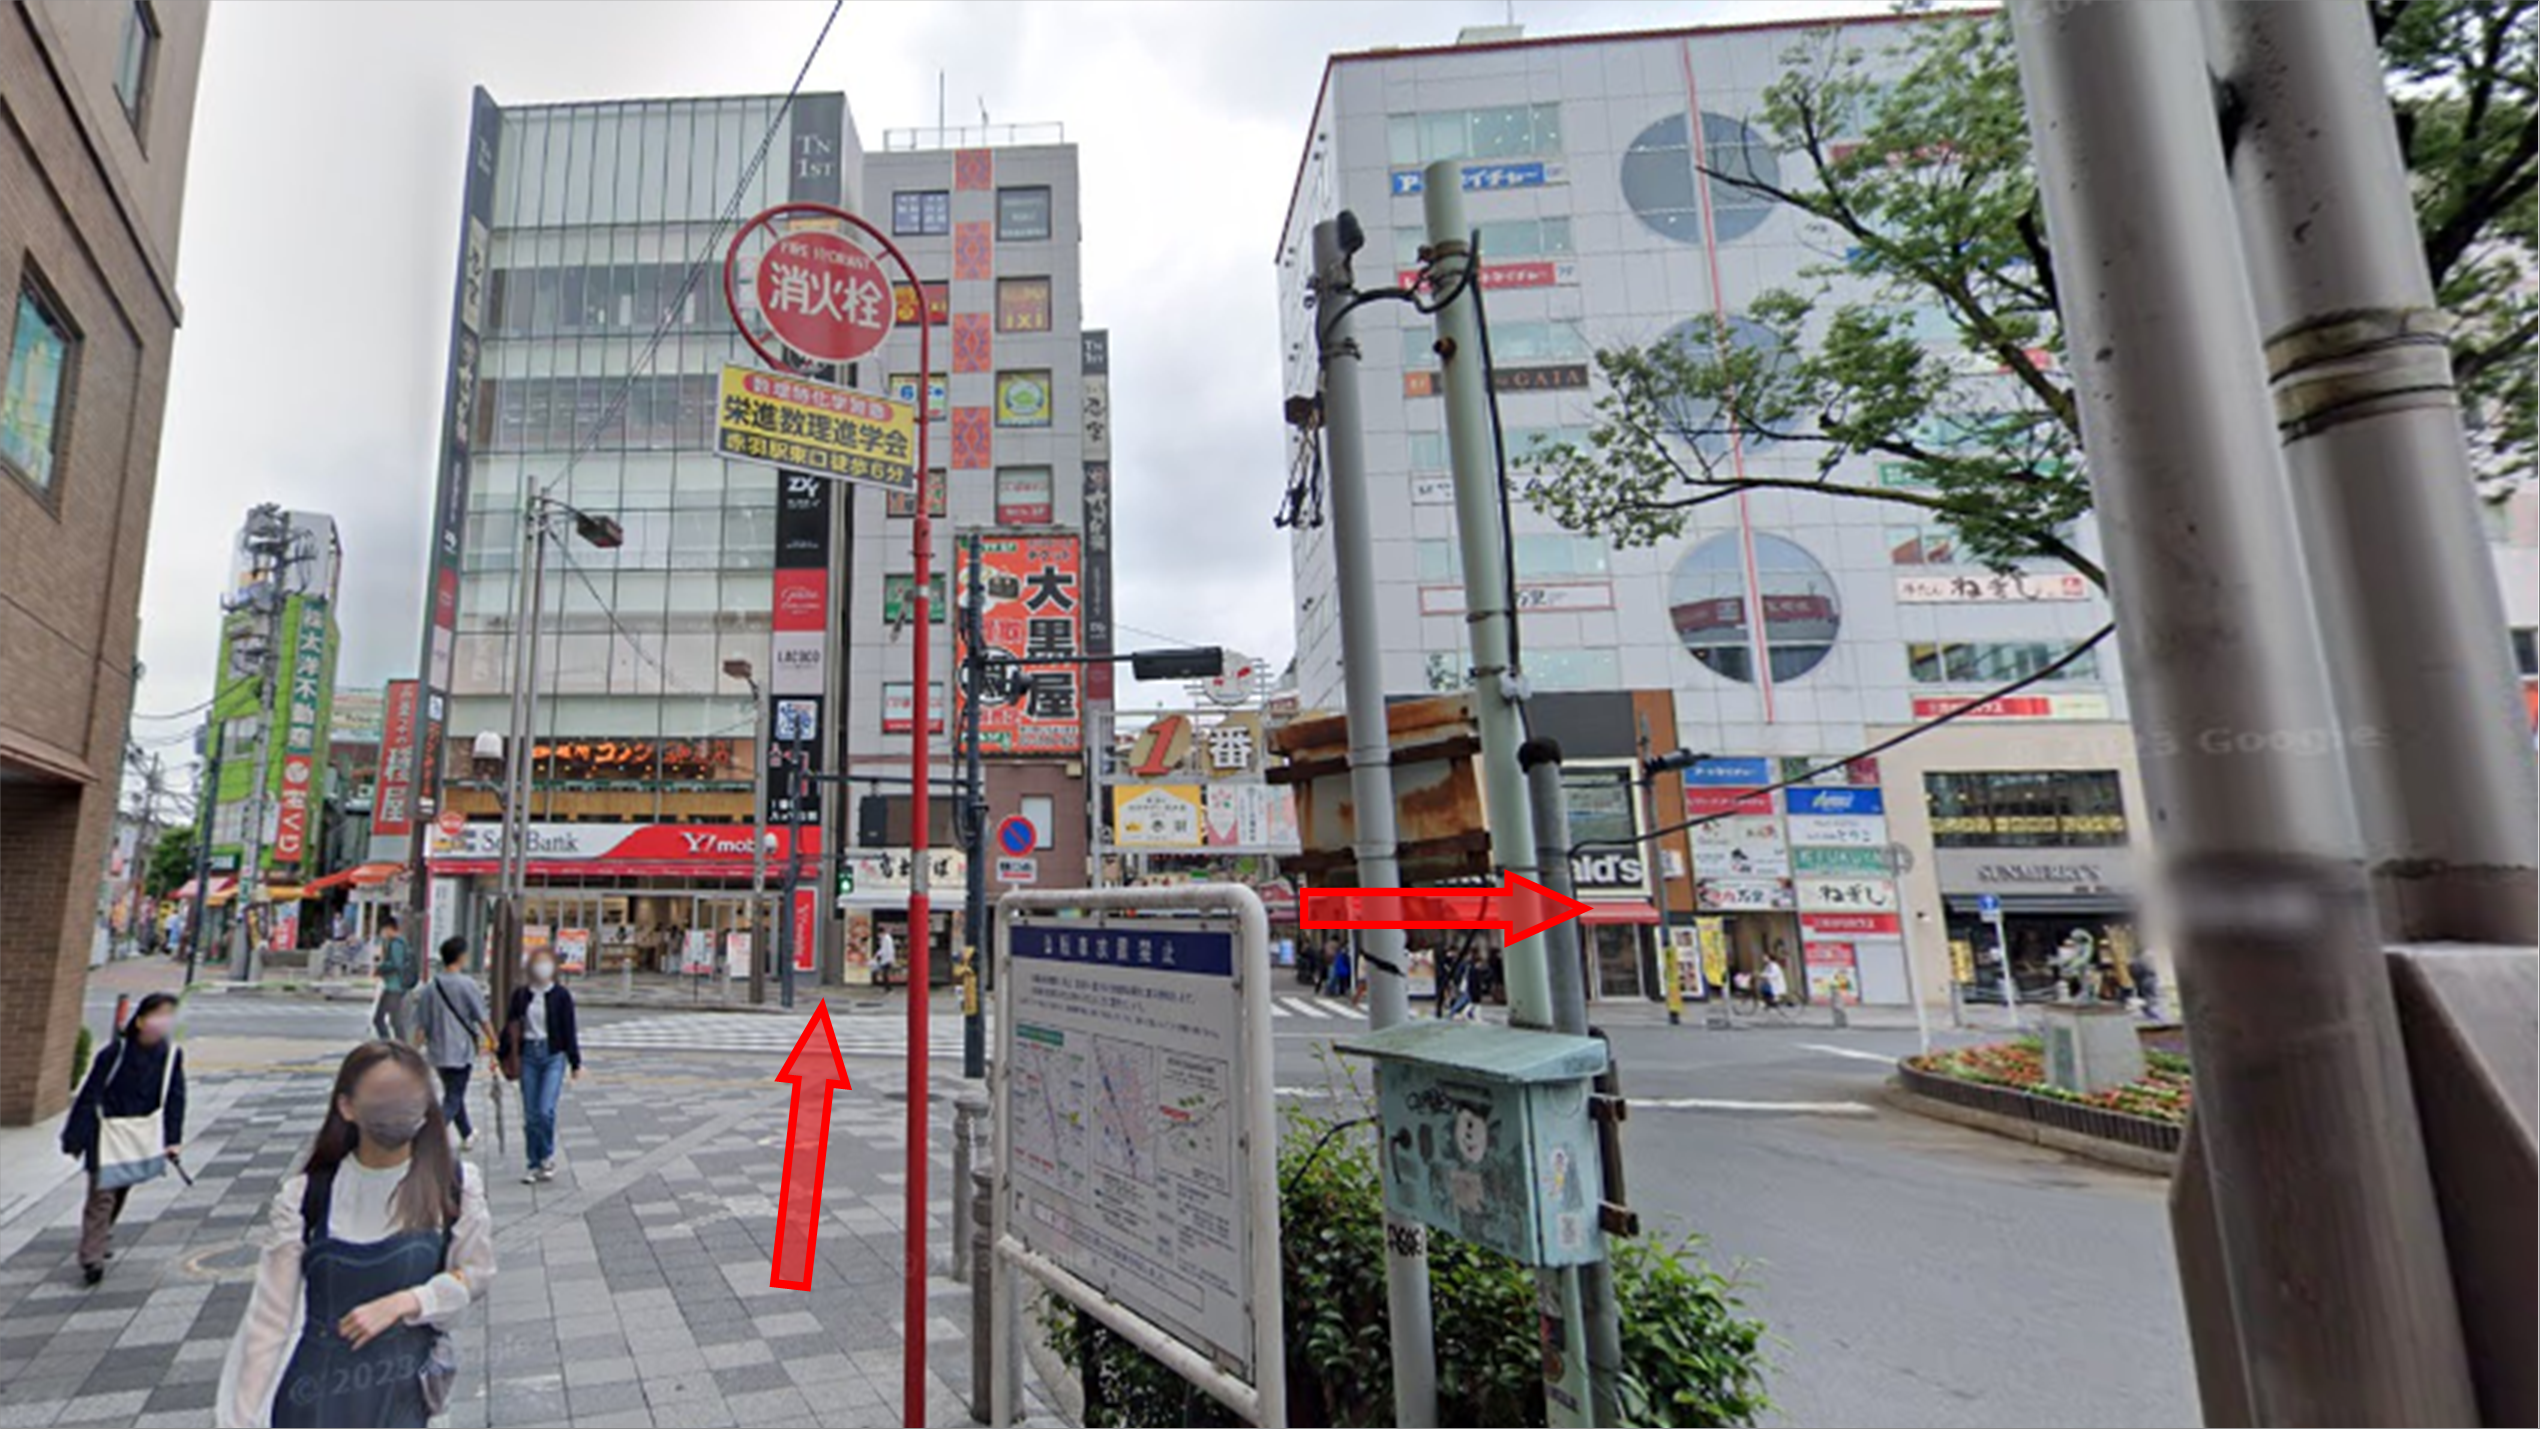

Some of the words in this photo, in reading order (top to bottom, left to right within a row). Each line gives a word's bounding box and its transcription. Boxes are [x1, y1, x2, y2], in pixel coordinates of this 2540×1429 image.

[768, 261, 884, 330] 消火栓
[724, 394, 908, 460] 栄進数理進学会
[1024, 564, 1076, 720] 大黒屋
[1209, 726, 1252, 769] 番
[482, 829, 579, 852] SoBank
[682, 831, 775, 853] Y!mob
